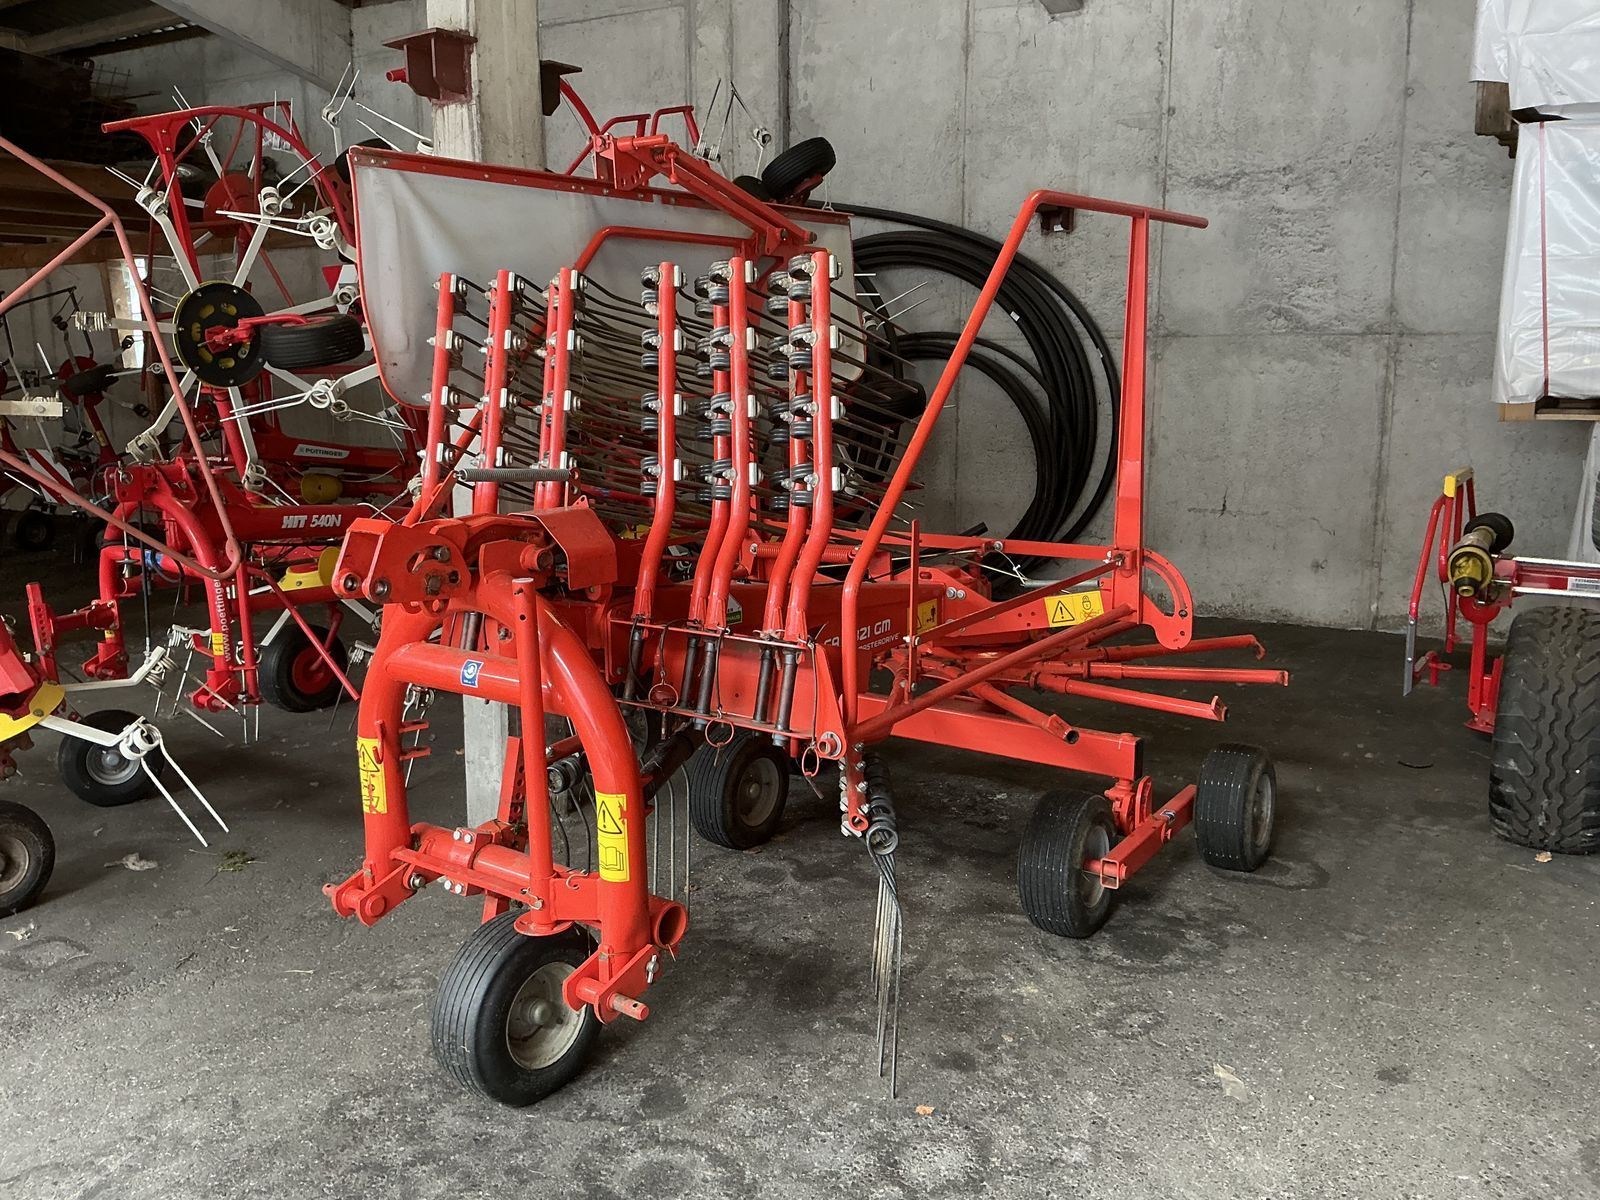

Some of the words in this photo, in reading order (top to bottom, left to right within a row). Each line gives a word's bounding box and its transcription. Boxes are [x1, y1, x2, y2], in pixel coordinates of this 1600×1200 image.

[281, 515, 308, 529] HIT
[310, 514, 342, 528] 540N
[874, 619, 891, 636] GM
